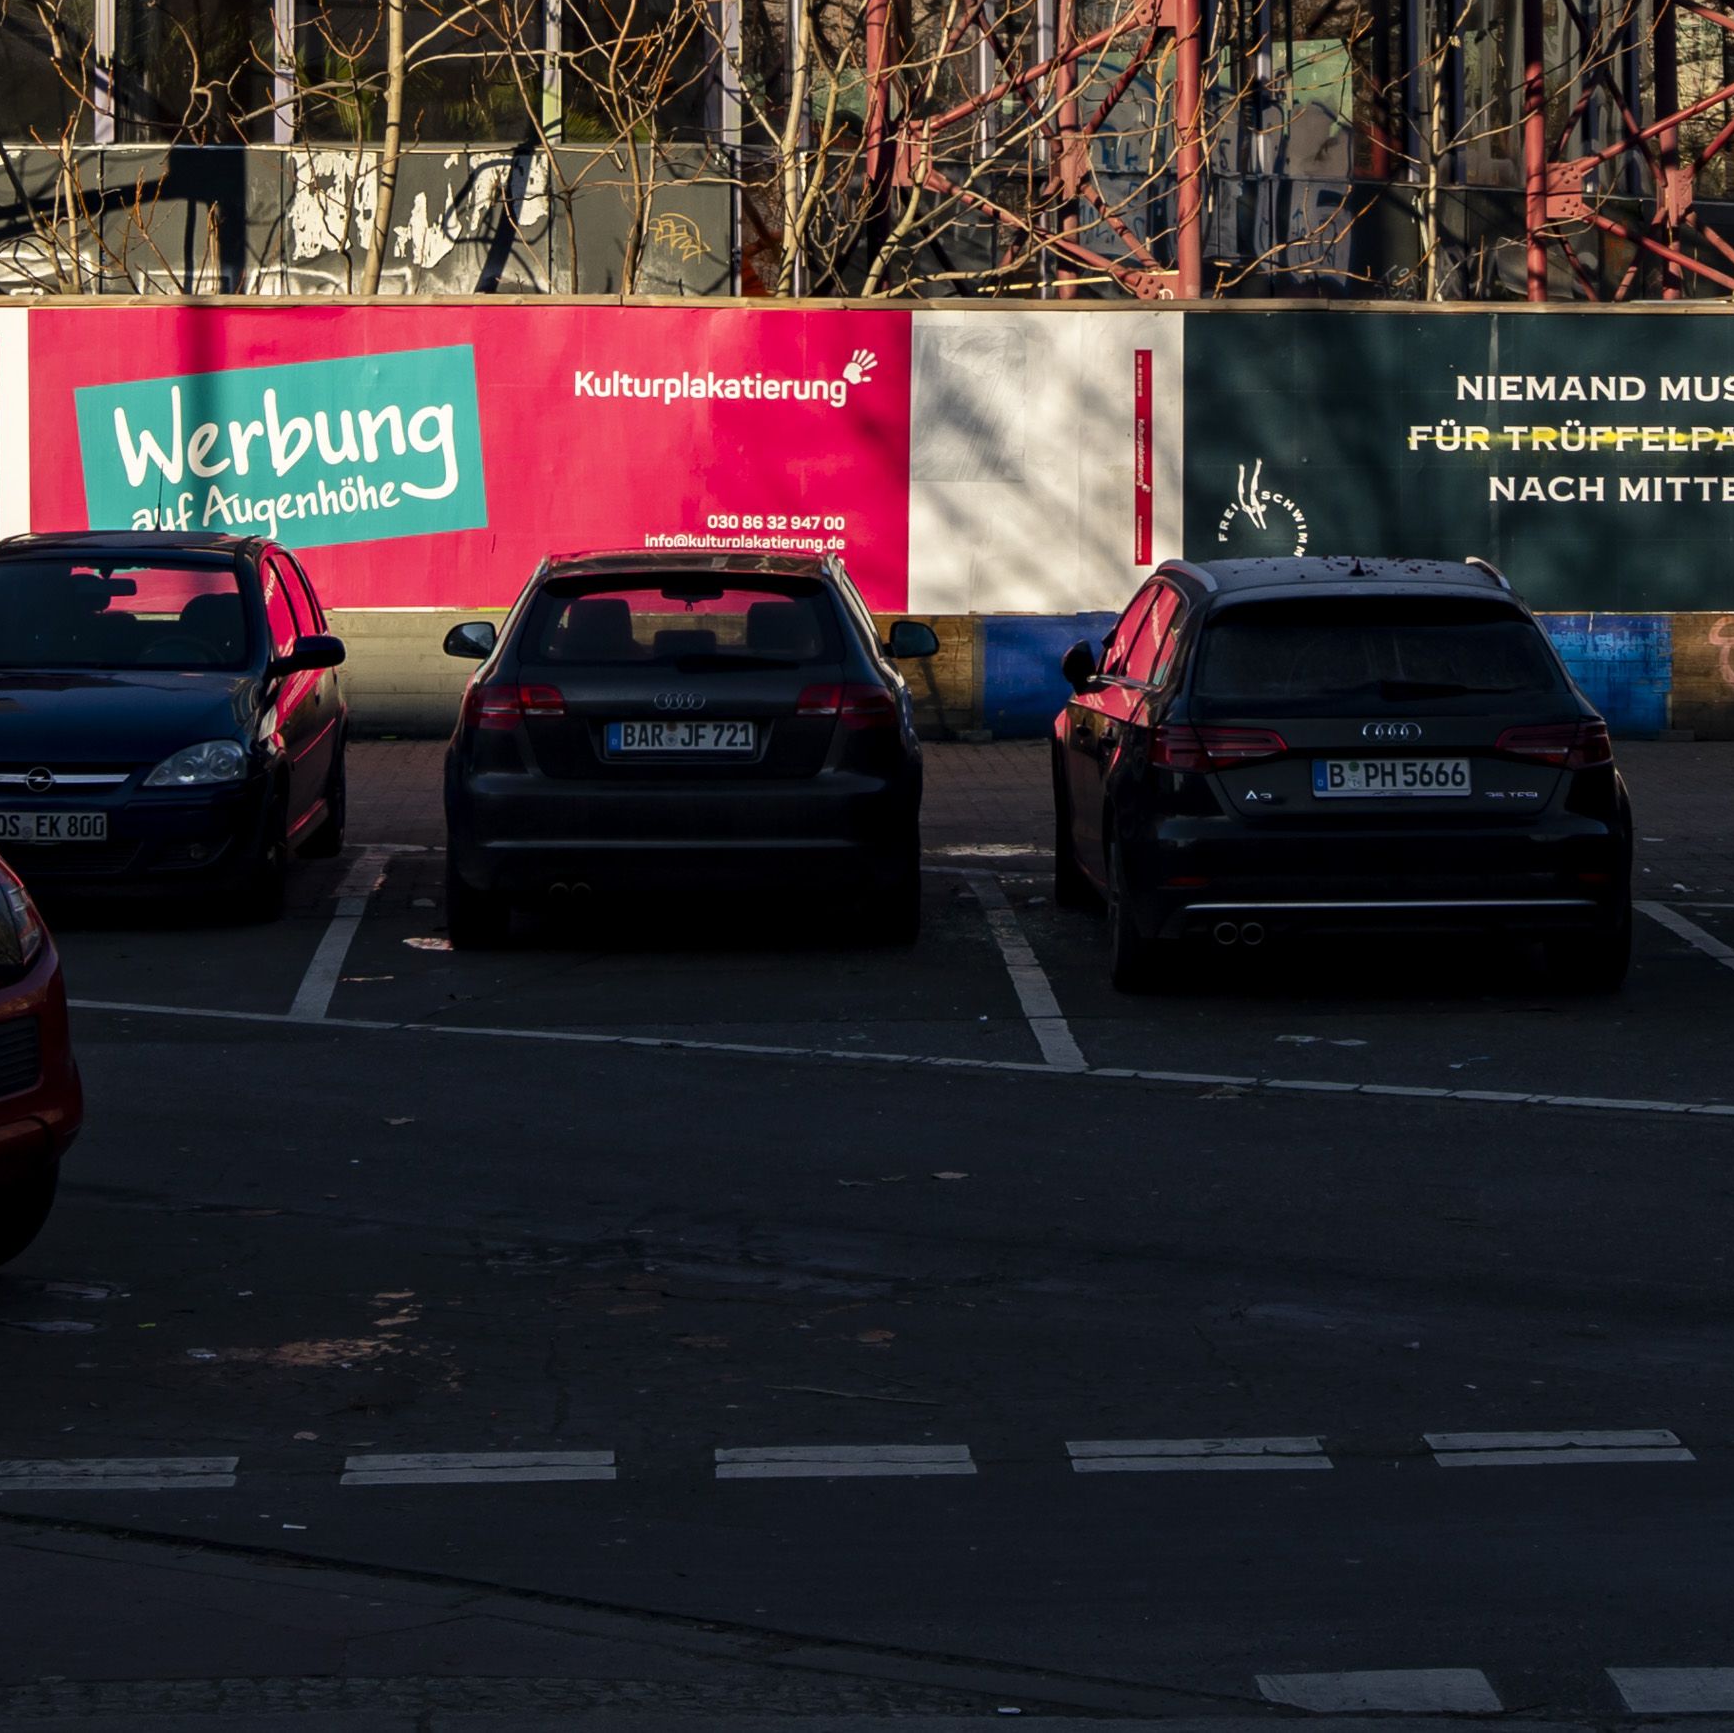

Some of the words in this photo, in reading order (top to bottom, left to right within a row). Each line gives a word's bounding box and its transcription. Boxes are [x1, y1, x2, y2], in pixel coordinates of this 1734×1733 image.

[574, 370, 848, 408] Kulturplakatierung
[1456, 375, 1646, 401] NIEMAND
[113, 384, 460, 500] Werbung
[1409, 419, 1490, 451] FÜR
[1489, 476, 1605, 502] NACH
[131, 492, 194, 531] auf
[202, 475, 401, 539] Augenhöhe
[707, 515, 739, 530] 030
[742, 515, 764, 530] 86
[766, 515, 787, 530] 32
[790, 515, 821, 530] 947
[823, 515, 846, 530] 00
[623, 723, 664, 748] BAR
[680, 723, 707, 748] JF
[713, 723, 752, 748] 721
[1329, 764, 1346, 788] B
[1364, 764, 1397, 788] PH
[1402, 762, 1466, 787] 5666
[36, 815, 61, 837] EK
[67, 815, 105, 837] 800
